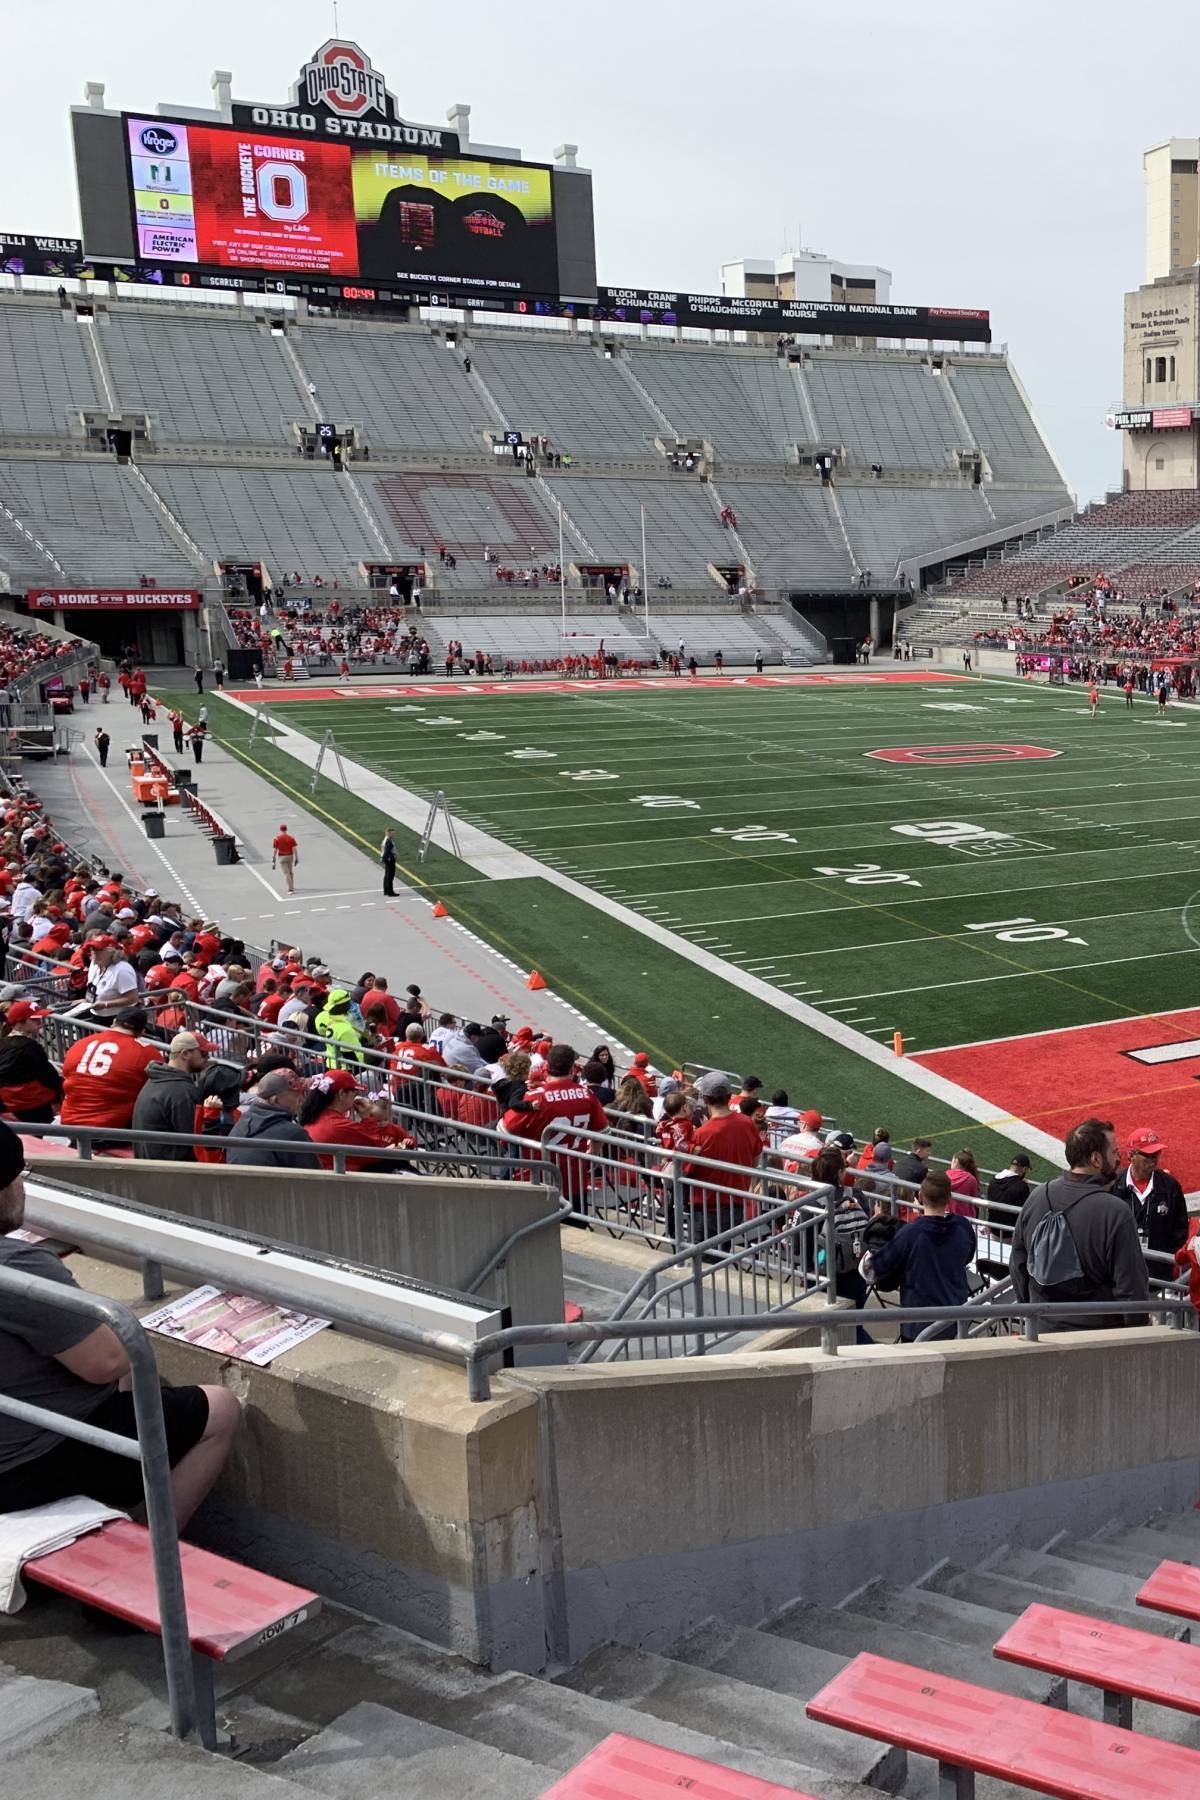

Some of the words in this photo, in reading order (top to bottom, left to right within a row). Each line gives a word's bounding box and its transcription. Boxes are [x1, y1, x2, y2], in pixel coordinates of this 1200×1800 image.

[308, 66, 339, 105] OHIO
[339, 62, 385, 113] STATE
[252, 107, 317, 131] OHIO
[325, 117, 443, 148] STADIUM
[143, 130, 175, 153] Kroger
[253, 144, 305, 161] CORNER
[238, 142, 256, 195] BUCKEYE
[375, 162, 424, 182] ITEMS
[429, 170, 448, 184] OF
[453, 172, 481, 189] THE
[487, 176, 529, 194] GAME
[242, 196, 257, 218] THE
[34, 237, 78, 250] WELLS
[152, 234, 194, 243] AMERICAN
[152, 240, 186, 248] ELECTRIC
[152, 245, 180, 253] POWER
[181, 273, 190, 285] 0
[209, 277, 243, 288] SCARLET
[410, 273, 437, 282] BUCKEYE
[438, 275, 461, 283] CORNER
[462, 278, 485, 286] STANDS
[486, 279, 497, 287] FOR
[498, 280, 521, 288] DETAILS
[276, 281, 284, 292] 0
[431, 294, 438, 304] 0
[607, 288, 637, 299] BLOCH
[648, 292, 678, 302] CRANE
[688, 295, 721, 305] PHIPPS
[731, 299, 779, 309] McCORKLE
[467, 298, 484, 307] GRAY
[519, 301, 527, 312] 0
[615, 297, 672, 310] SCHUMAKER
[690, 303, 762, 316] O'SHAUGHNESSY
[789, 301, 846, 312] HUNTINGTON
[849, 305, 892, 315] NATIONAL
[893, 307, 917, 316] BANK
[782, 309, 817, 319] NOURSE
[929, 308, 938, 317] Pay
[939, 309, 961, 317] Forward
[961, 310, 979, 318] Society
[58, 593, 98, 604] HOME
[126, 593, 192, 605] BUCKEYES
[558, 768, 620, 781] 50
[628, 794, 697, 809] 40
[710, 824, 790, 842] 30
[812, 863, 911, 885] 20
[963, 917, 1070, 943] 10
[76, 1039, 120, 1077] 16
[545, 1087, 590, 1102] GEORGE
[550, 1114, 591, 1149] 27
[291, 1613, 299, 1624] 7
